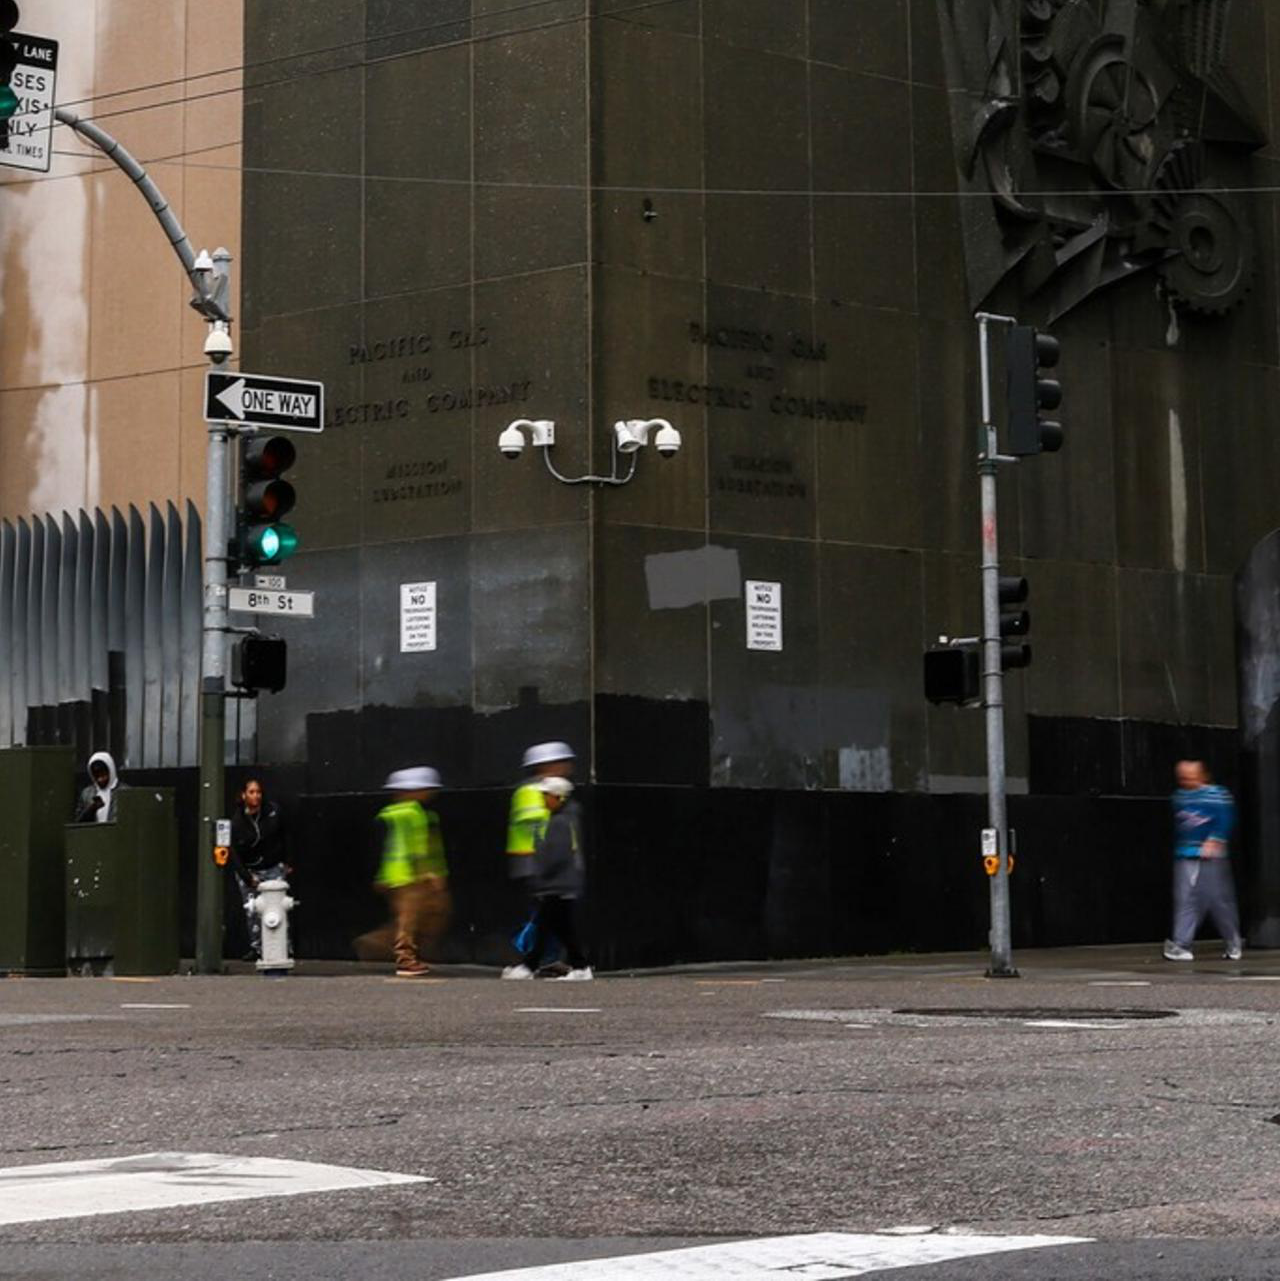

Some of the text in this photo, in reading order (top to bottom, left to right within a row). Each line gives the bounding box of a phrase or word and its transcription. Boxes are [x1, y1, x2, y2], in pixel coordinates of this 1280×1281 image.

[23, 44, 54, 62] LANE
[13, 72, 46, 92] SES
[16, 97, 41, 115] XIS
[8, 119, 37, 138] NLY
[16, 144, 43, 159] TIMES
[349, 333, 432, 366] PACIFIC
[241, 390, 313, 416] ONE WAY
[324, 380, 532, 428] LECTRIC COMPANY
[646, 376, 868, 424] ELECTRIC COMPANY
[248, 593, 293, 610] 8th St
[411, 594, 425, 605] NO
[756, 593, 772, 604] NO
